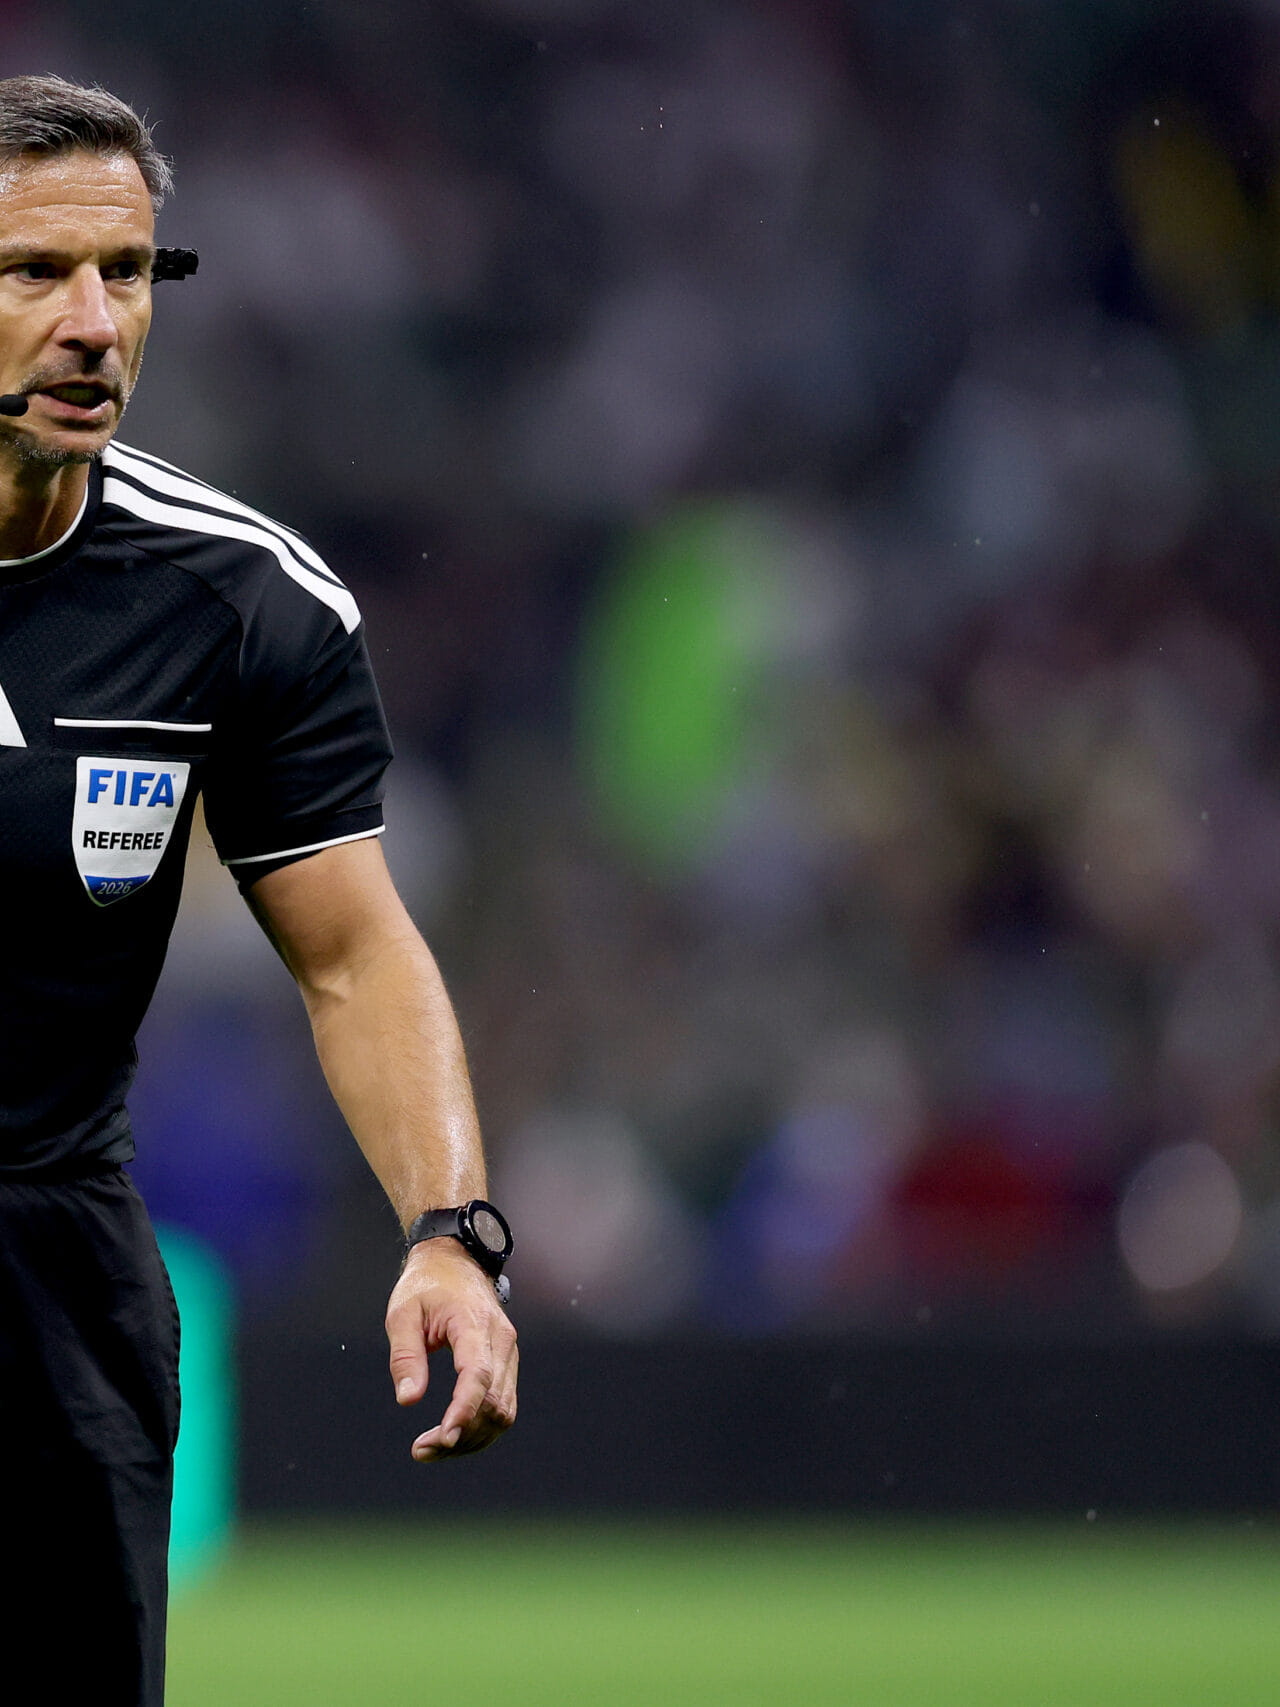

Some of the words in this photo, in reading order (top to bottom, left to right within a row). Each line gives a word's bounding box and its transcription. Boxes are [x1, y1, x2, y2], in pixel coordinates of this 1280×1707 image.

[88, 769, 175, 808] FIFA
[83, 830, 165, 851] REFEREE
[97, 881, 133, 895] 2026
